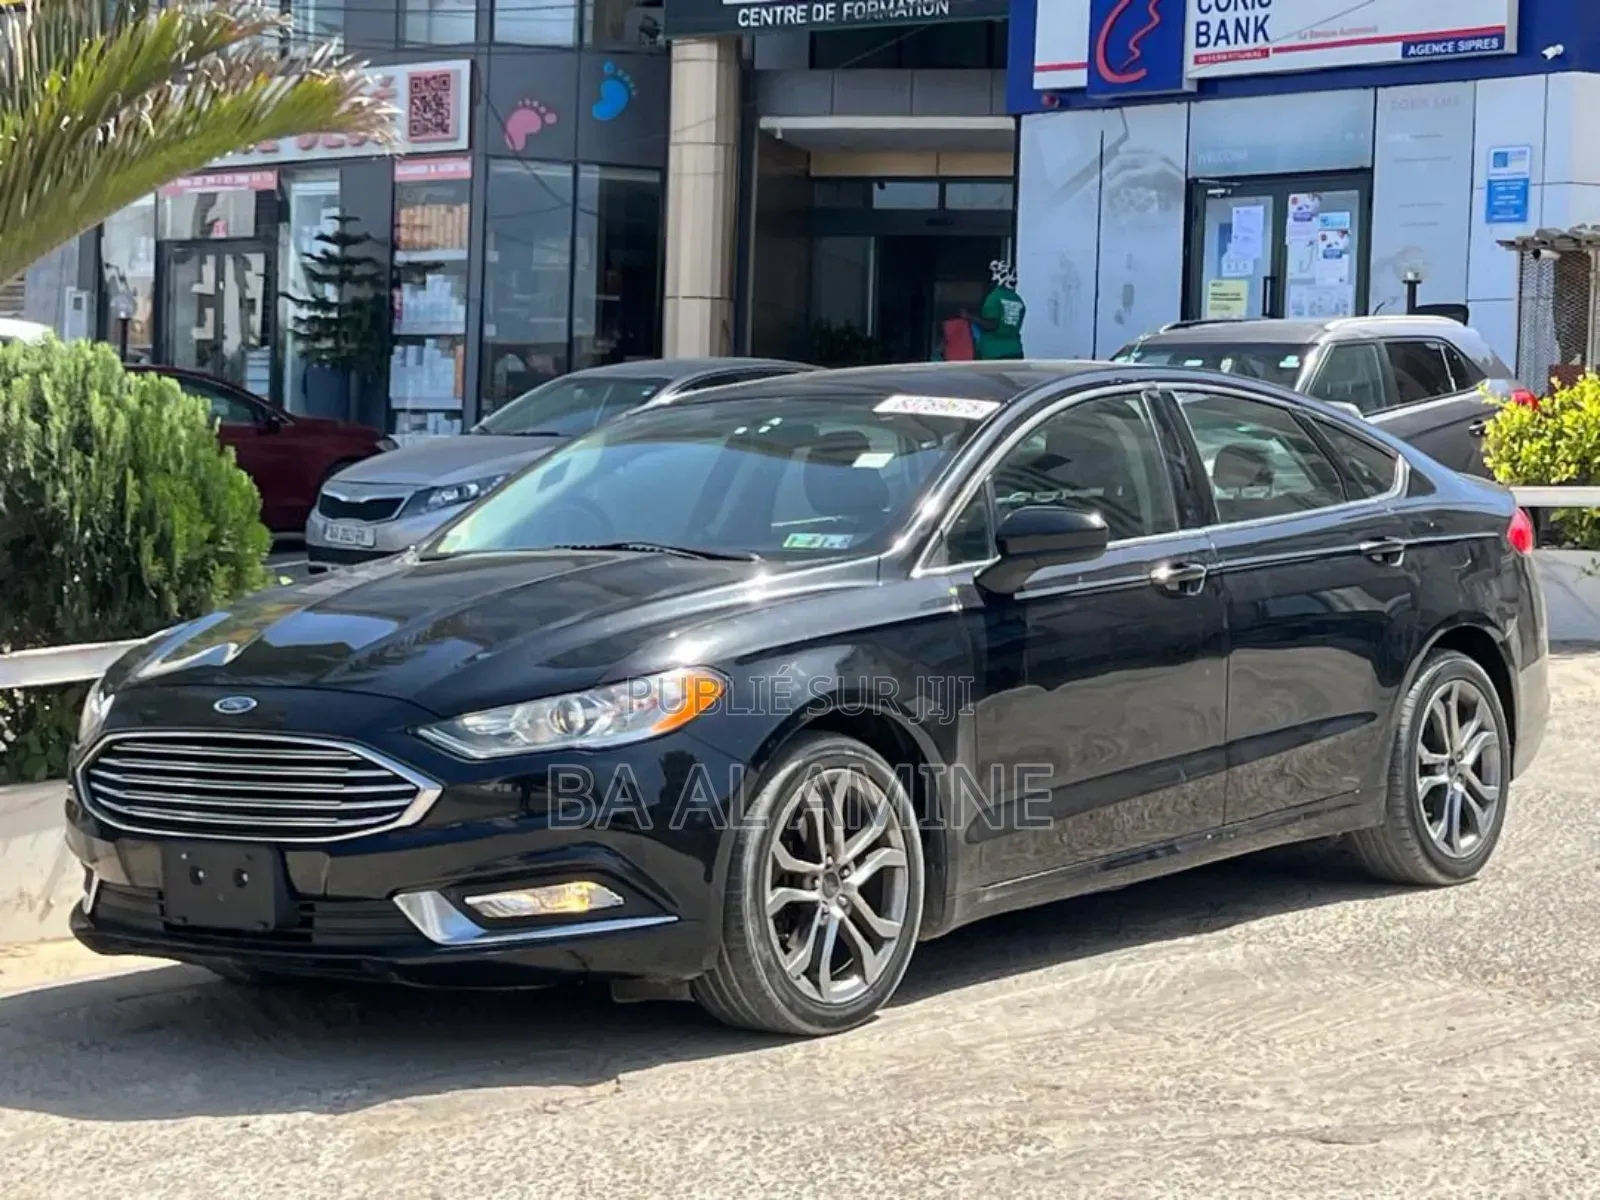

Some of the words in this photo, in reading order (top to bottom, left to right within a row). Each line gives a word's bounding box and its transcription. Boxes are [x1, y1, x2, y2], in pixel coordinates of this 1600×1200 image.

[738, 5, 808, 27] CENTRE
[812, 3, 837, 22] DE
[842, 0, 949, 21] FORMATION
[1195, 15, 1270, 48] BANK
[1408, 41, 1453, 56] AGENCE
[1457, 38, 1498, 52] SIPRES
